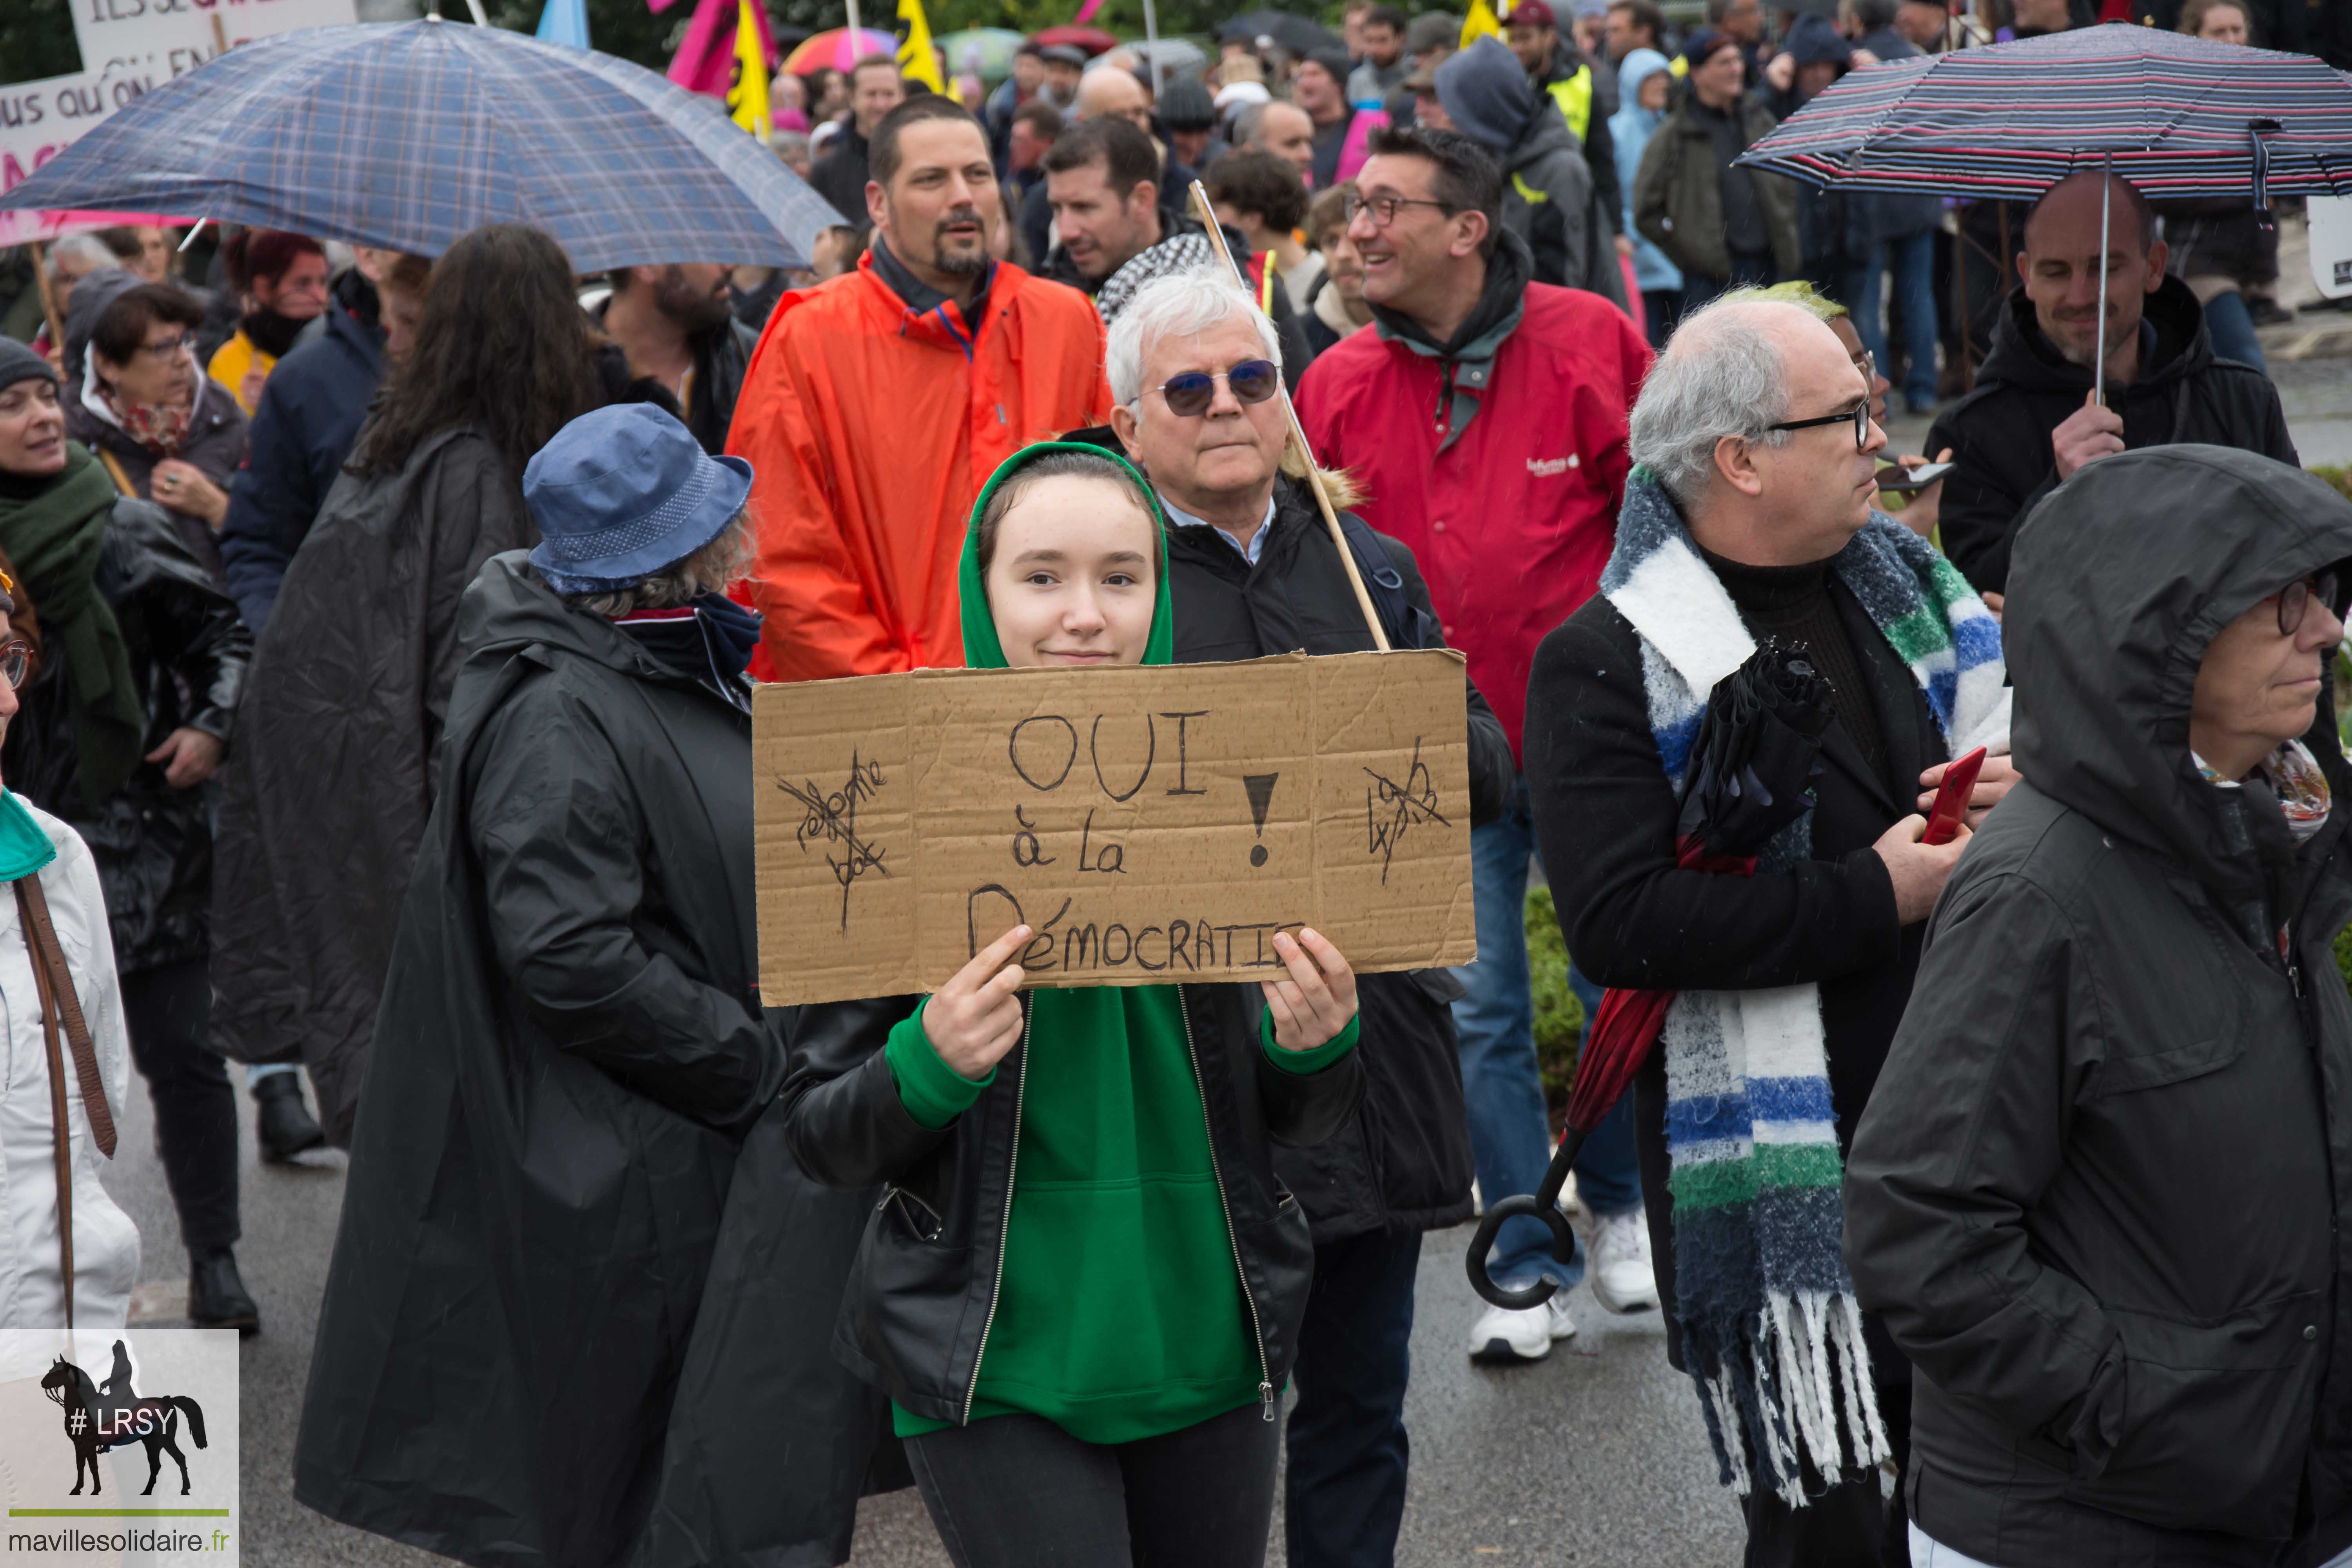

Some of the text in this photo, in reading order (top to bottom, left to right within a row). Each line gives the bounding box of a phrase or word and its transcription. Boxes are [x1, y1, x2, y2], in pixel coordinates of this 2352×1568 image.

[0, 93, 43, 128] US
[1009, 710, 1213, 802] OUI
[1011, 804, 1056, 867] à
